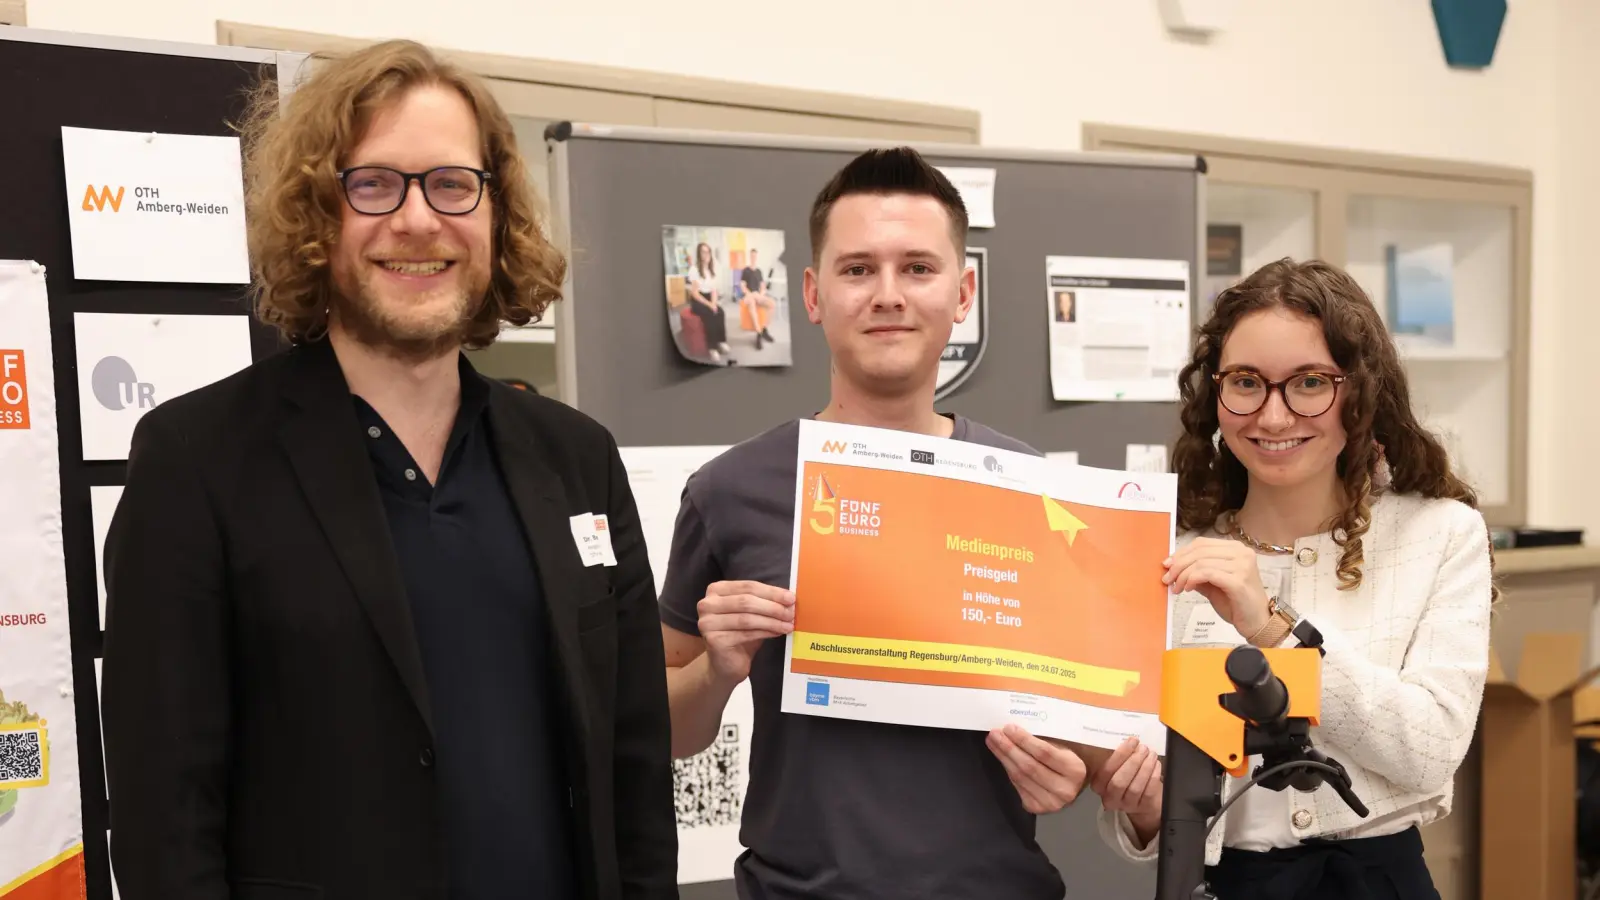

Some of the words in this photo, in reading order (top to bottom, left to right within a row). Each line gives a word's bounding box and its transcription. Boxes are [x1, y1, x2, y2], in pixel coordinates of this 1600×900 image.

[134, 187, 159, 198] OTH
[136, 201, 229, 215] Amberg-Weiden
[119, 382, 157, 409] UR
[852, 449, 904, 460] Amberg-Weiden
[912, 452, 933, 463] OTH
[840, 499, 881, 514] FÜNF
[840, 512, 881, 528] EURO
[839, 527, 879, 537] BUSINESS
[946, 533, 1034, 563] Medienpreis
[963, 562, 1018, 583] Preisgeld
[962, 588, 973, 601] in
[975, 591, 1000, 605] Höhe
[1002, 598, 1020, 608] von
[961, 607, 992, 624] 150,-
[995, 611, 1022, 627] Euro
[809, 642, 908, 660] Abschlussveranstaltung
[910, 650, 1025, 670] Regensburg/Amberg-Weiden,
[1026, 661, 1039, 671] den
[1041, 664, 1077, 679] 24.07.2025
